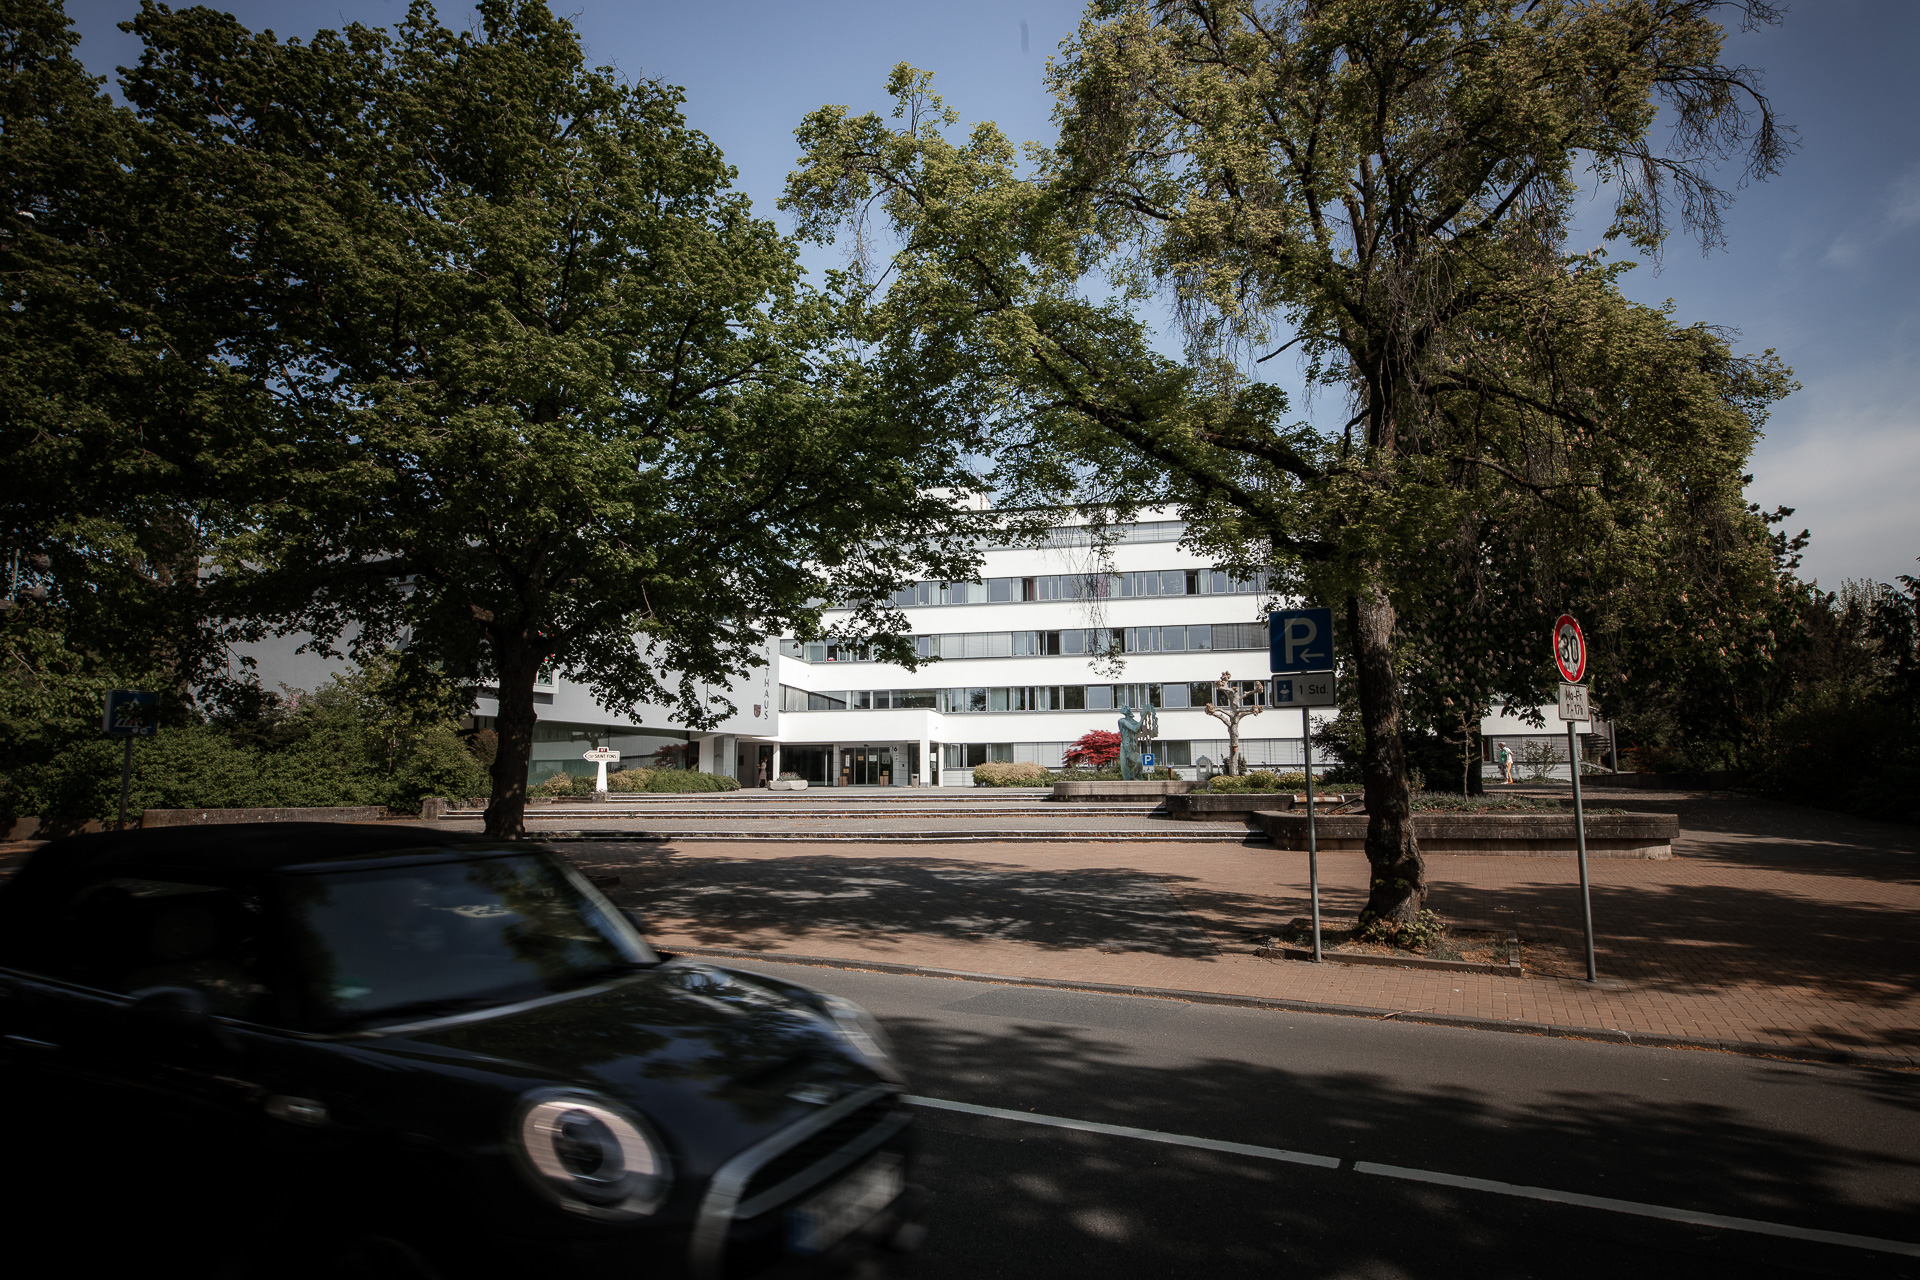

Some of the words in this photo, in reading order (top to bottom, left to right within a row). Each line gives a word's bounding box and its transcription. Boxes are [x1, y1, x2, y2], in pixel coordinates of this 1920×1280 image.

[1284, 617, 1317, 664] P
[1560, 634, 1578, 664] 30
[1299, 685, 1303, 695] 1
[1308, 684, 1329, 695] Std.
[1144, 755, 1152, 764] P
